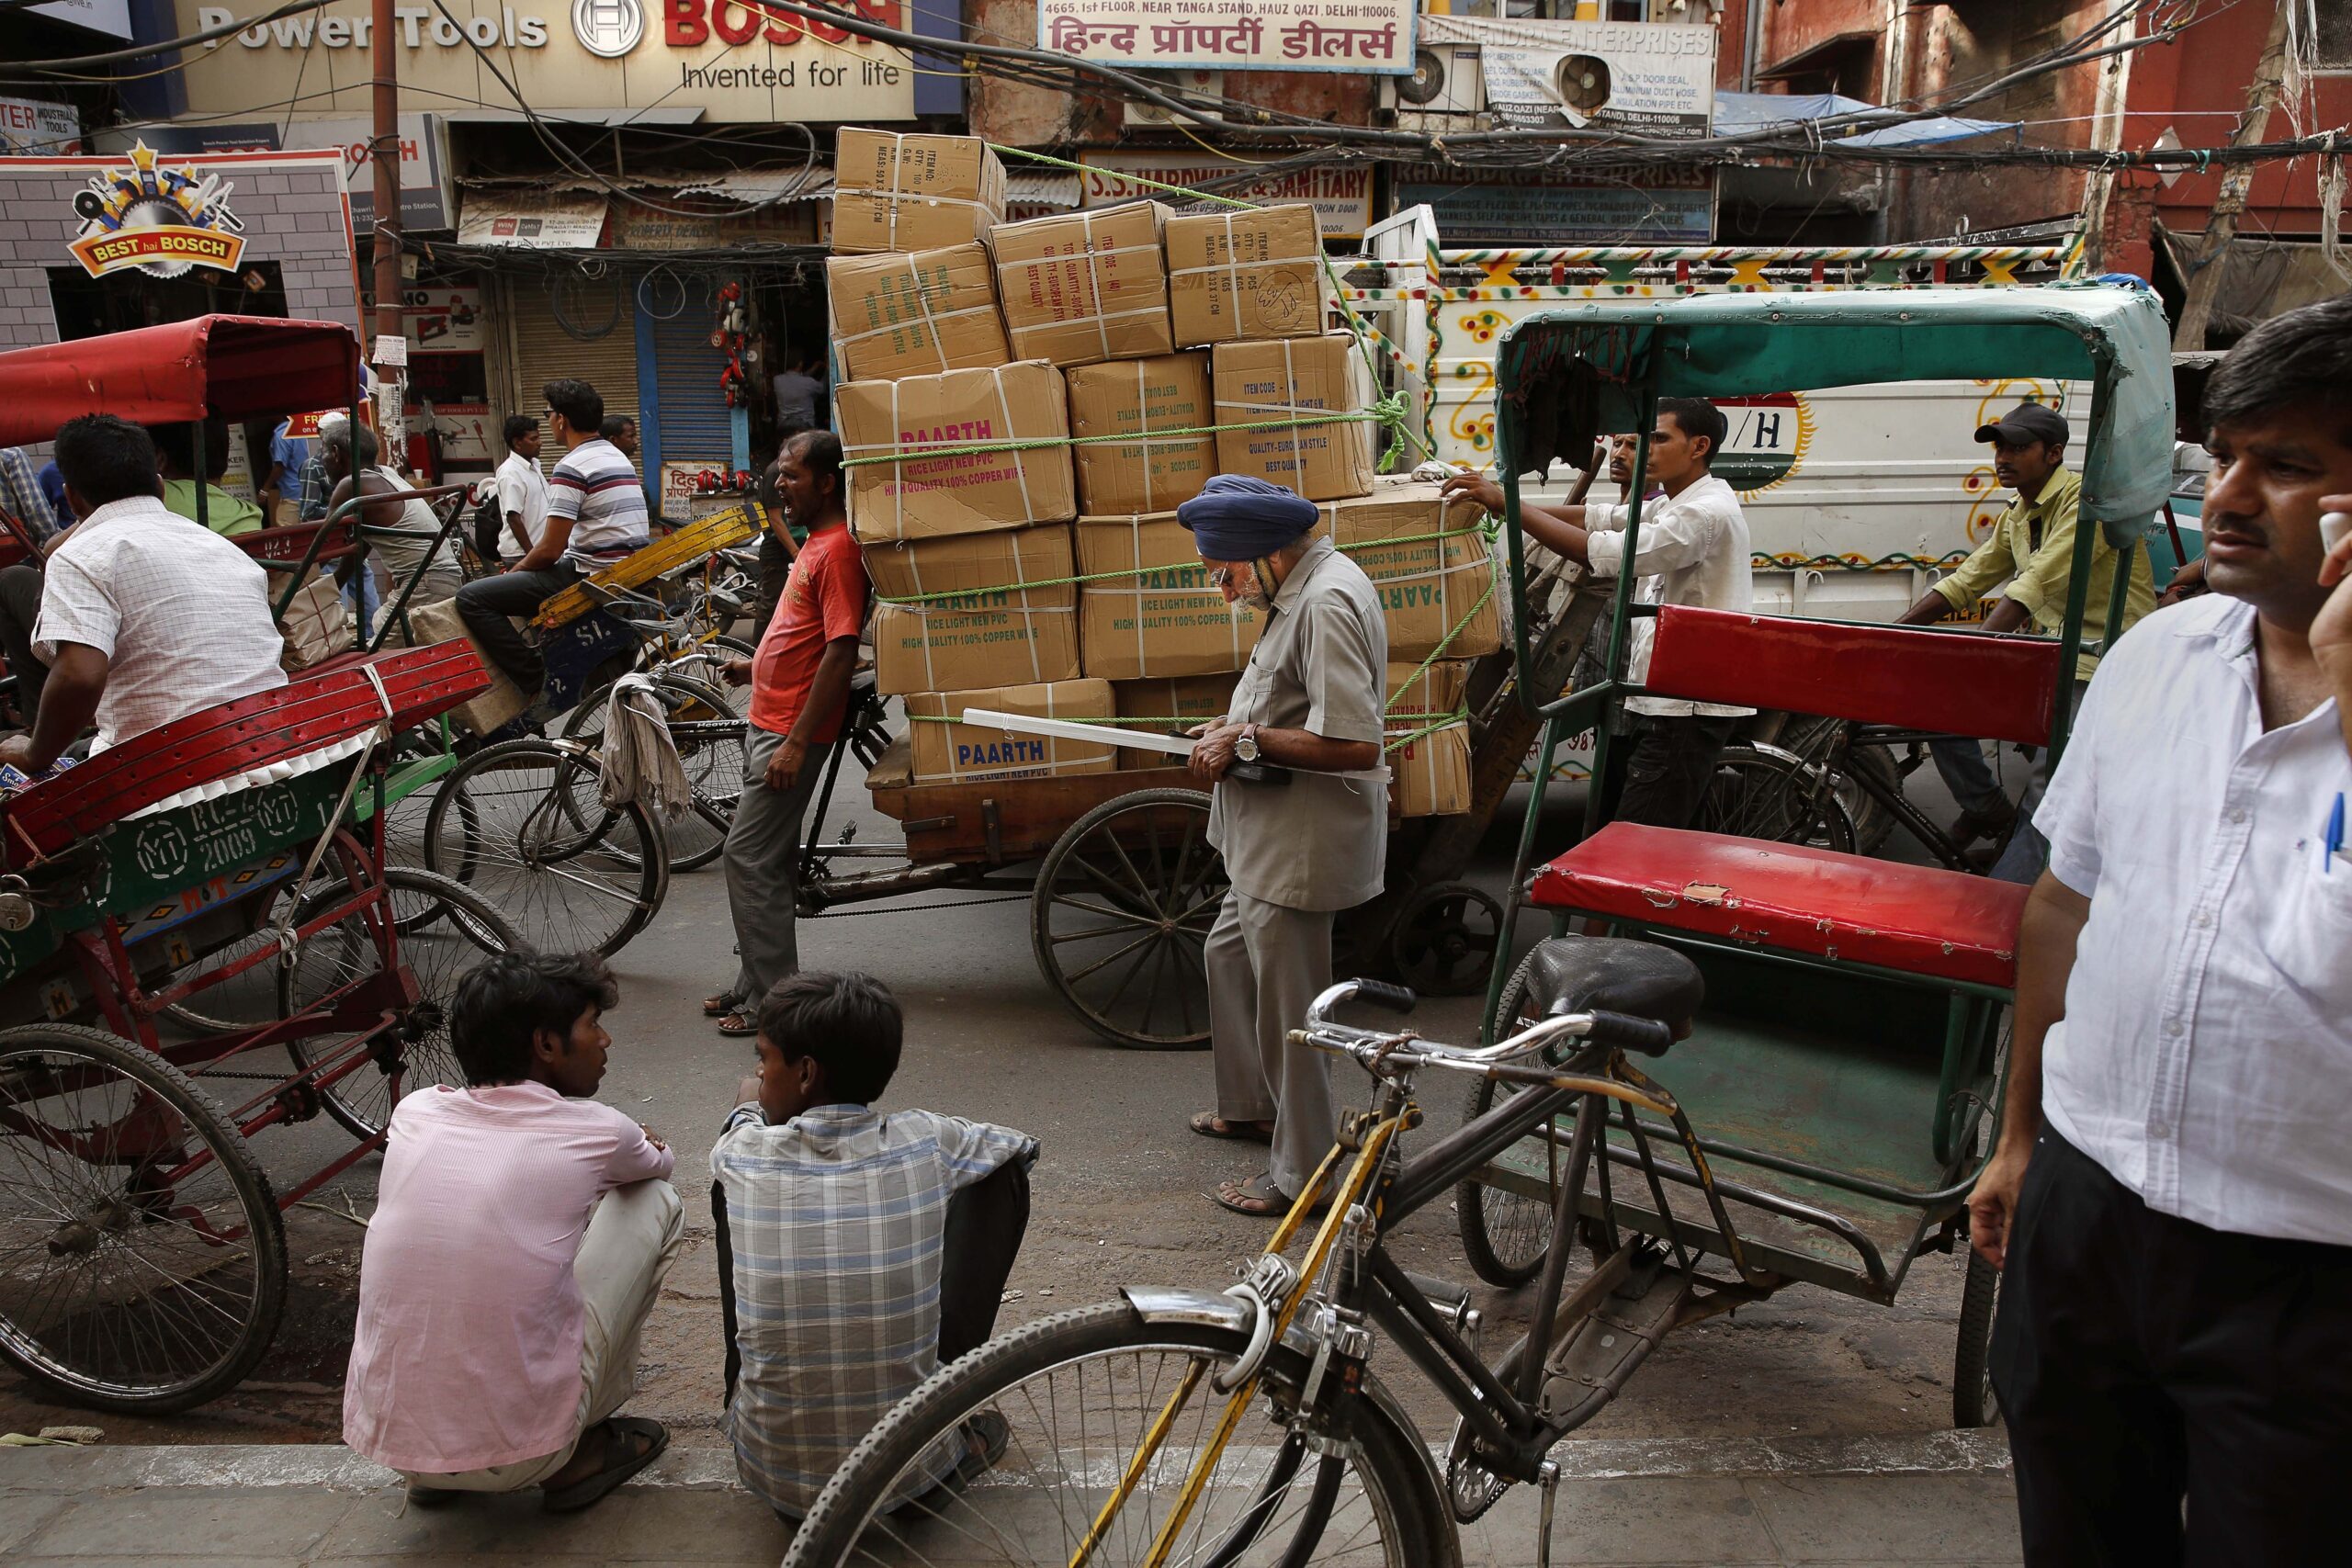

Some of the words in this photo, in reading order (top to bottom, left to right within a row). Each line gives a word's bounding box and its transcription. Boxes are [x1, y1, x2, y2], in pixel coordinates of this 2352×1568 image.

[1082, 3, 1098, 13] 1st
[1143, 3, 1172, 14] NEAR
[1177, 3, 1215, 15] TANGA
[1260, 4, 1288, 15] HAUZ
[198, 6, 373, 49] Power
[394, 6, 548, 48] Tools
[1047, 16, 1140, 55] हिन्द
[1149, 17, 1264, 54] प्रॉपर्टी
[1280, 19, 1396, 59] डीलर्स
[1560, 27, 1710, 56] ENTERPRISES
[682, 61, 796, 89] Invented
[808, 61, 847, 87] for
[862, 59, 899, 86] life
[1643, 74, 1665, 85] DOOR
[1654, 87, 1675, 96] DUCT
[1514, 104, 1532, 114] QAZI
[1658, 99, 1676, 108] PIPE
[1627, 113, 1680, 124] DELHI-110006
[46, 121, 68, 134] TOOLS
[876, 146, 887, 169] MEAS:
[927, 150, 937, 169] ITEM
[1270, 168, 1369, 199] SANITARY
[1205, 235, 1216, 259] MEAS:
[1244, 233, 1253, 251] QTY:
[1258, 231, 1268, 249] ITEM
[93, 239, 139, 263] BEST
[142, 241, 158, 253] hai
[160, 236, 226, 257] BOSCH
[1062, 242, 1076, 264] TOTL
[1027, 265, 1039, 282] BEST
[1248, 276, 1257, 290] PCS
[1030, 282, 1044, 308] QUALITY
[1162, 384, 1178, 397] BEST
[1244, 382, 1259, 395] ITEM
[1259, 381, 1275, 394] CODE
[1117, 410, 1136, 422] STYLE
[900, 419, 993, 455] PAARTH
[1308, 436, 1328, 449] STYLE
[907, 459, 929, 477] RICE
[929, 457, 955, 475] LIGHT
[956, 455, 976, 470] NEW
[977, 453, 994, 467] PVC
[1170, 461, 1187, 472] CODE
[1186, 458, 1201, 471] ITEM
[1265, 461, 1281, 472] BEST
[907, 478, 944, 493] QUALITY
[945, 475, 967, 491] 100%
[969, 470, 1003, 486] COPPER
[1385, 551, 1408, 564] 100%
[1159, 598, 1184, 611] LIGHT
[1187, 596, 1206, 608] NEW
[1206, 595, 1224, 608] PVC
[945, 616, 970, 630] LIGHT
[971, 615, 989, 628] NEW
[991, 614, 1008, 626] PVC
[1114, 618, 1135, 631] HIGH
[1136, 616, 1172, 630] UALITY
[1174, 614, 1196, 627] 100%
[901, 637, 924, 649] HIGH
[924, 635, 958, 649] UALITY
[960, 633, 982, 646] 100%
[983, 630, 1016, 644] COPPER
[957, 739, 1045, 766] PAARTH
[690, 785, 729, 818] NEELAM
[199, 828, 257, 874] 2009
